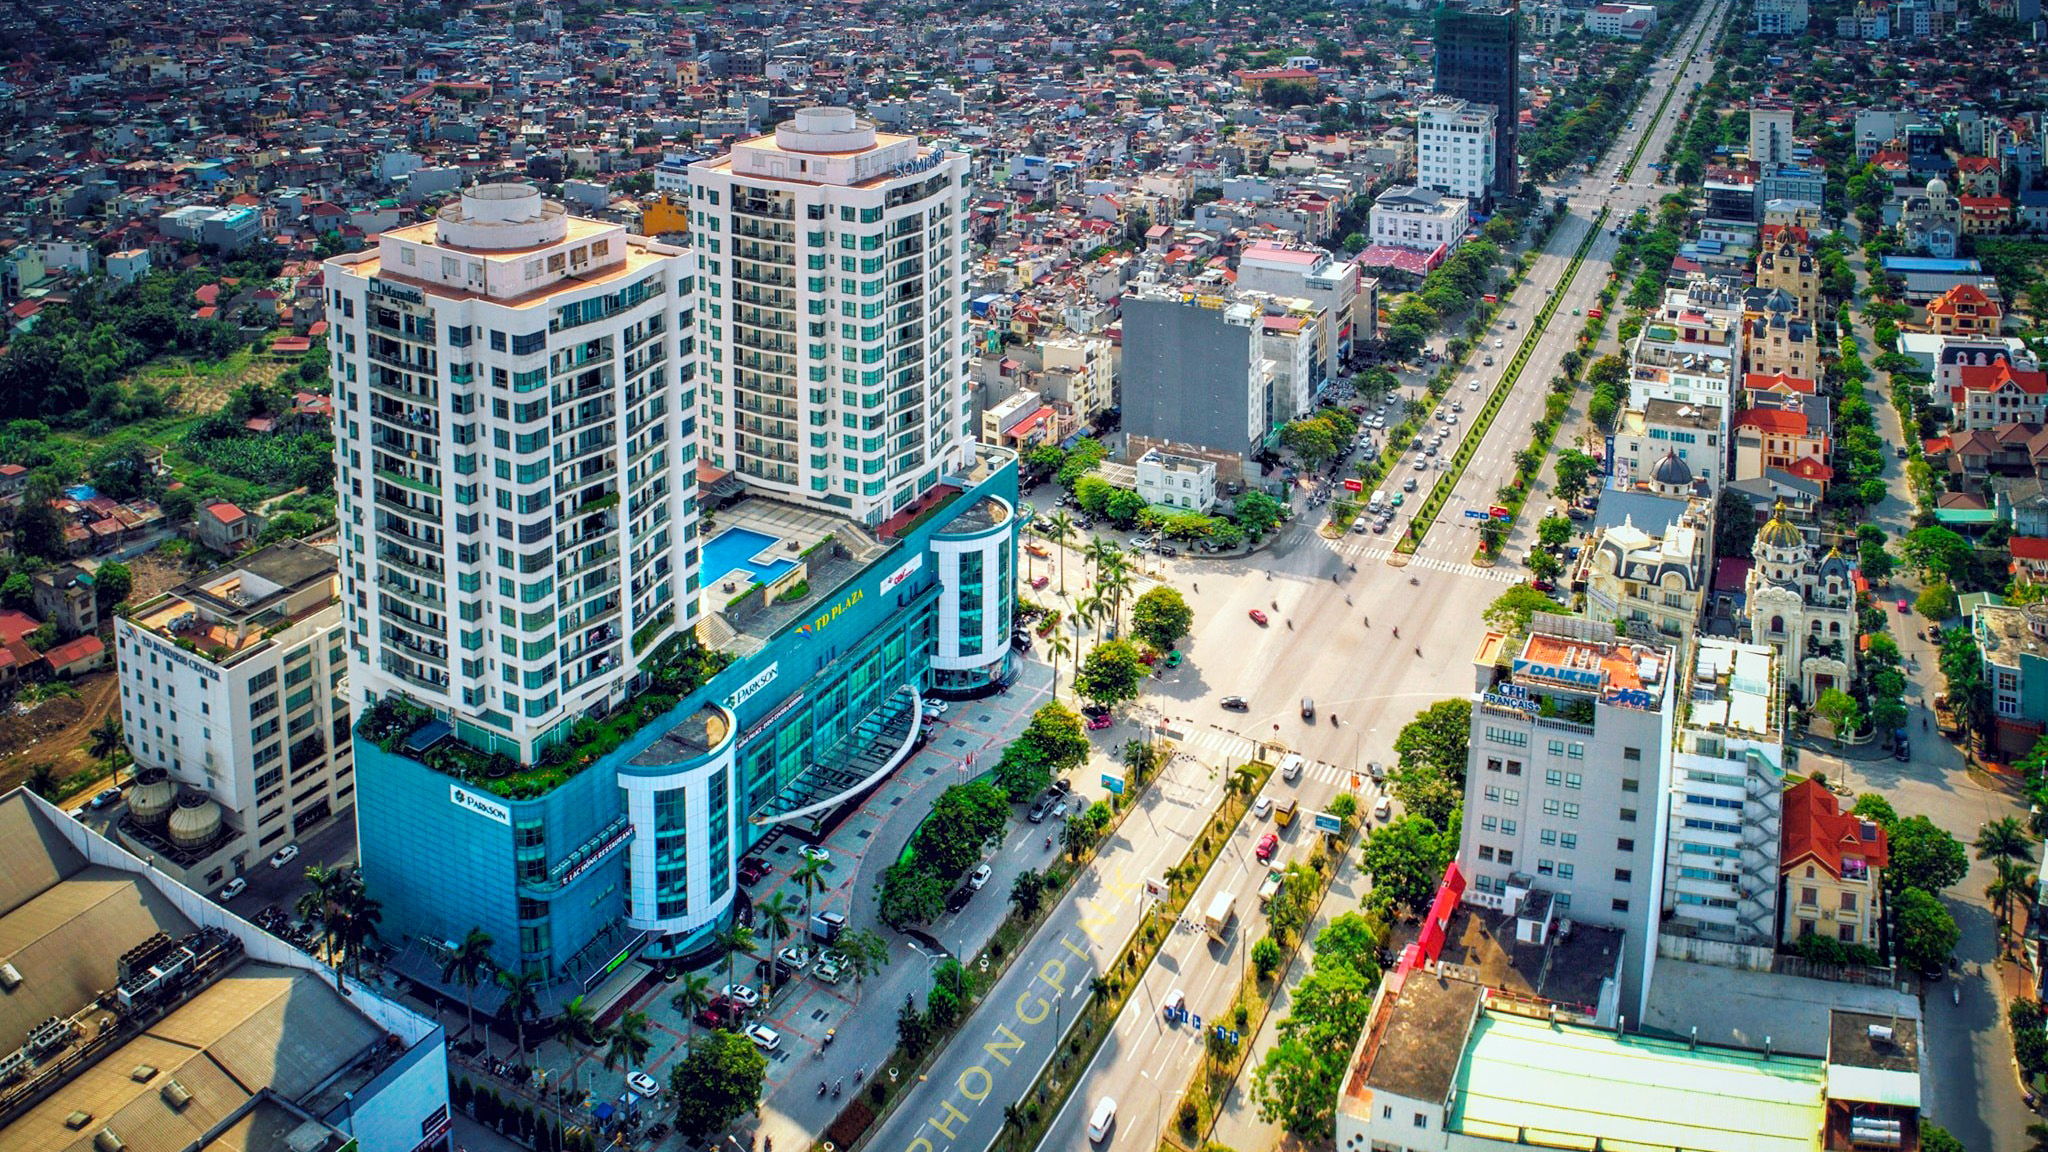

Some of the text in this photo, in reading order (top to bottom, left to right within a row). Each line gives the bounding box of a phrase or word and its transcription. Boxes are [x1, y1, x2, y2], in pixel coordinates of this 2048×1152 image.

[381, 283, 422, 305] Manulife
[815, 588, 863, 631] TD PLAZA
[141, 635, 221, 682] TD BUSINESS CENTER
[737, 669, 777, 703] PARKSON
[1530, 664, 1600, 685] DAIKIN
[467, 796, 506, 820] PARKSON
[598, 828, 634, 859] RESTAURANT
